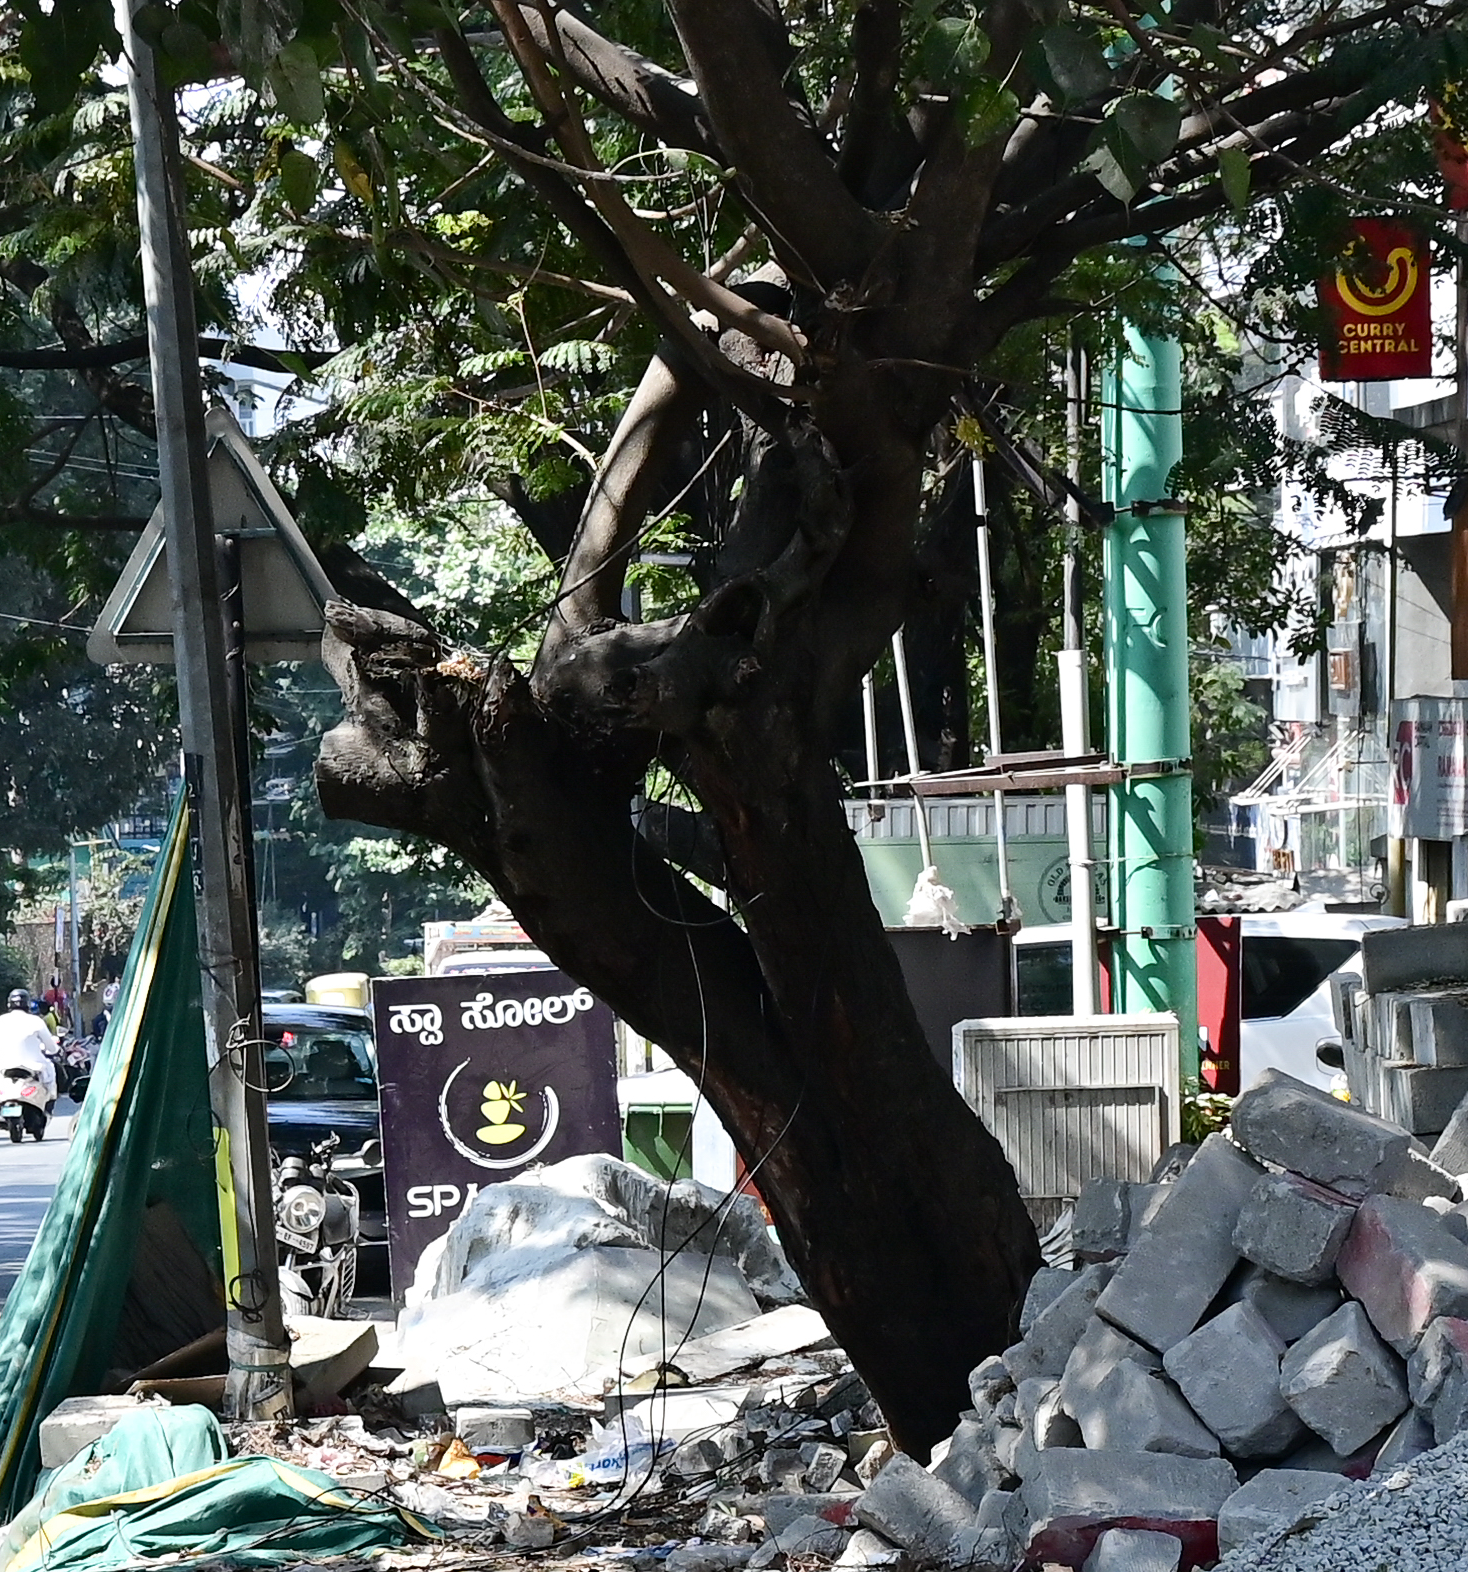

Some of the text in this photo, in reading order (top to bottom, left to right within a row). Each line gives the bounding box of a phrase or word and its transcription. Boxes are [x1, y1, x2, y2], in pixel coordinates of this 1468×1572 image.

[1343, 322, 1406, 337] CURRY
[1338, 338, 1419, 354] CENTRAL
[1047, 867, 1064, 887] OLD
[459, 986, 594, 1030] ಸೋಲ್
